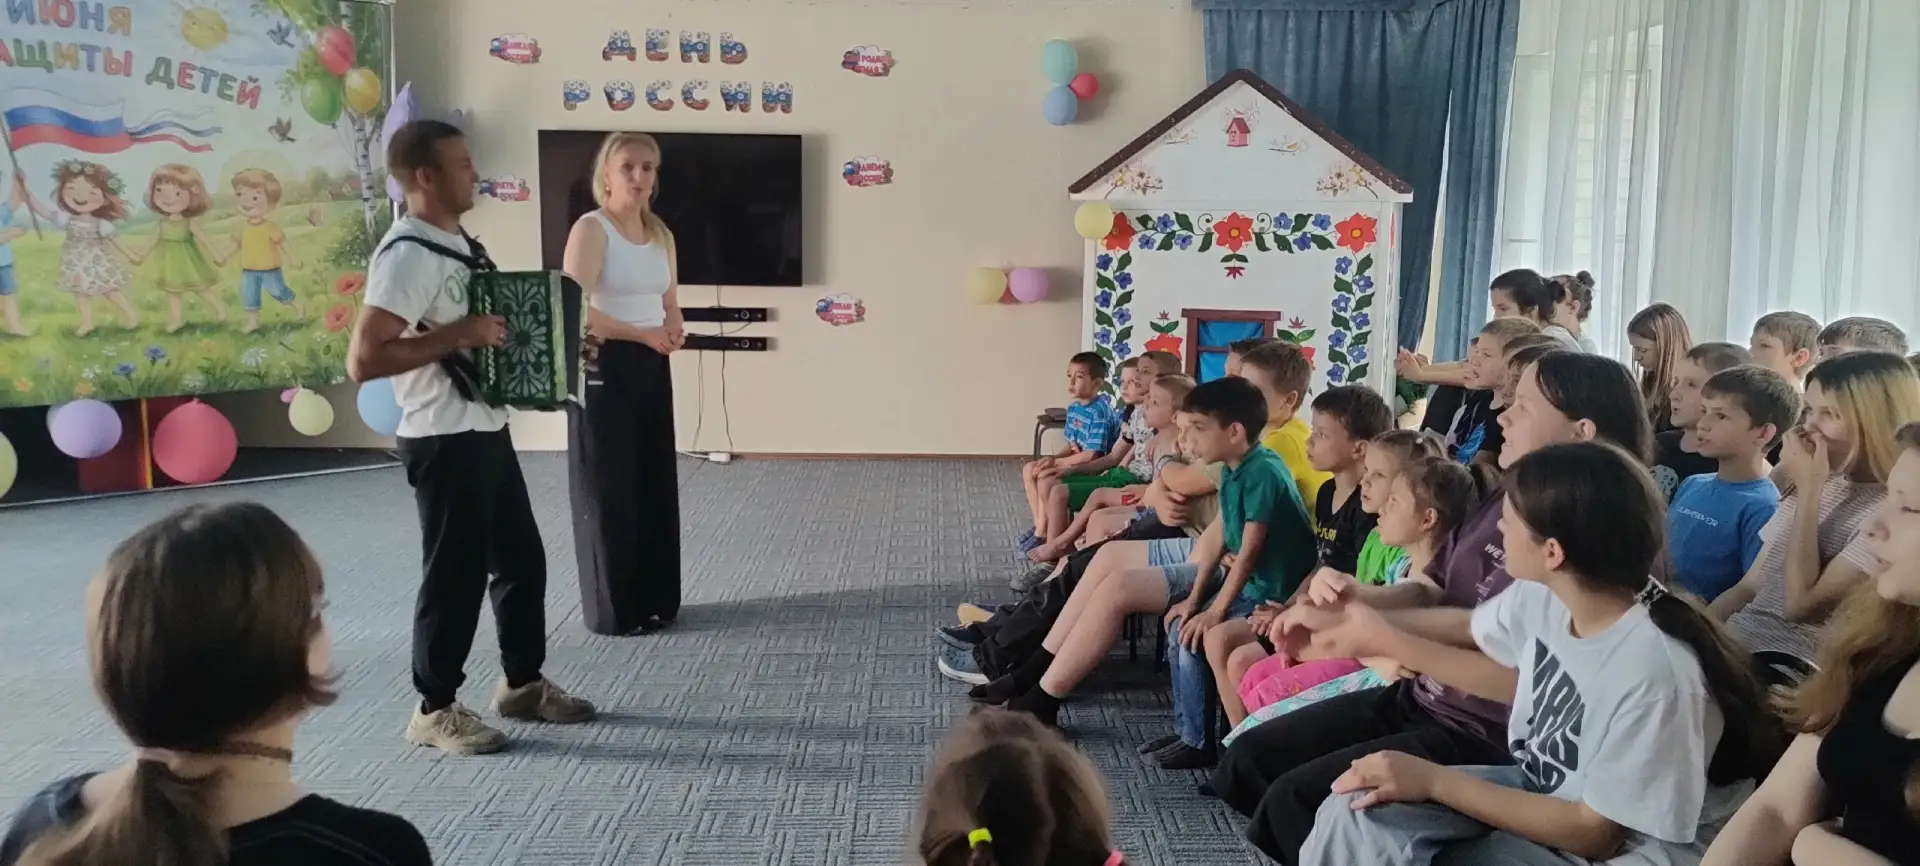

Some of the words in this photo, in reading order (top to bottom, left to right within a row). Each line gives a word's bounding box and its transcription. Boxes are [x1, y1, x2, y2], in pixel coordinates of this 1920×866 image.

[6, 0, 132, 36] ИЮНЯ
[602, 27, 749, 65] ДЕНЬ
[145, 56, 262, 110] ДЕТЕЙ
[563, 78, 794, 115] РОССИИ
